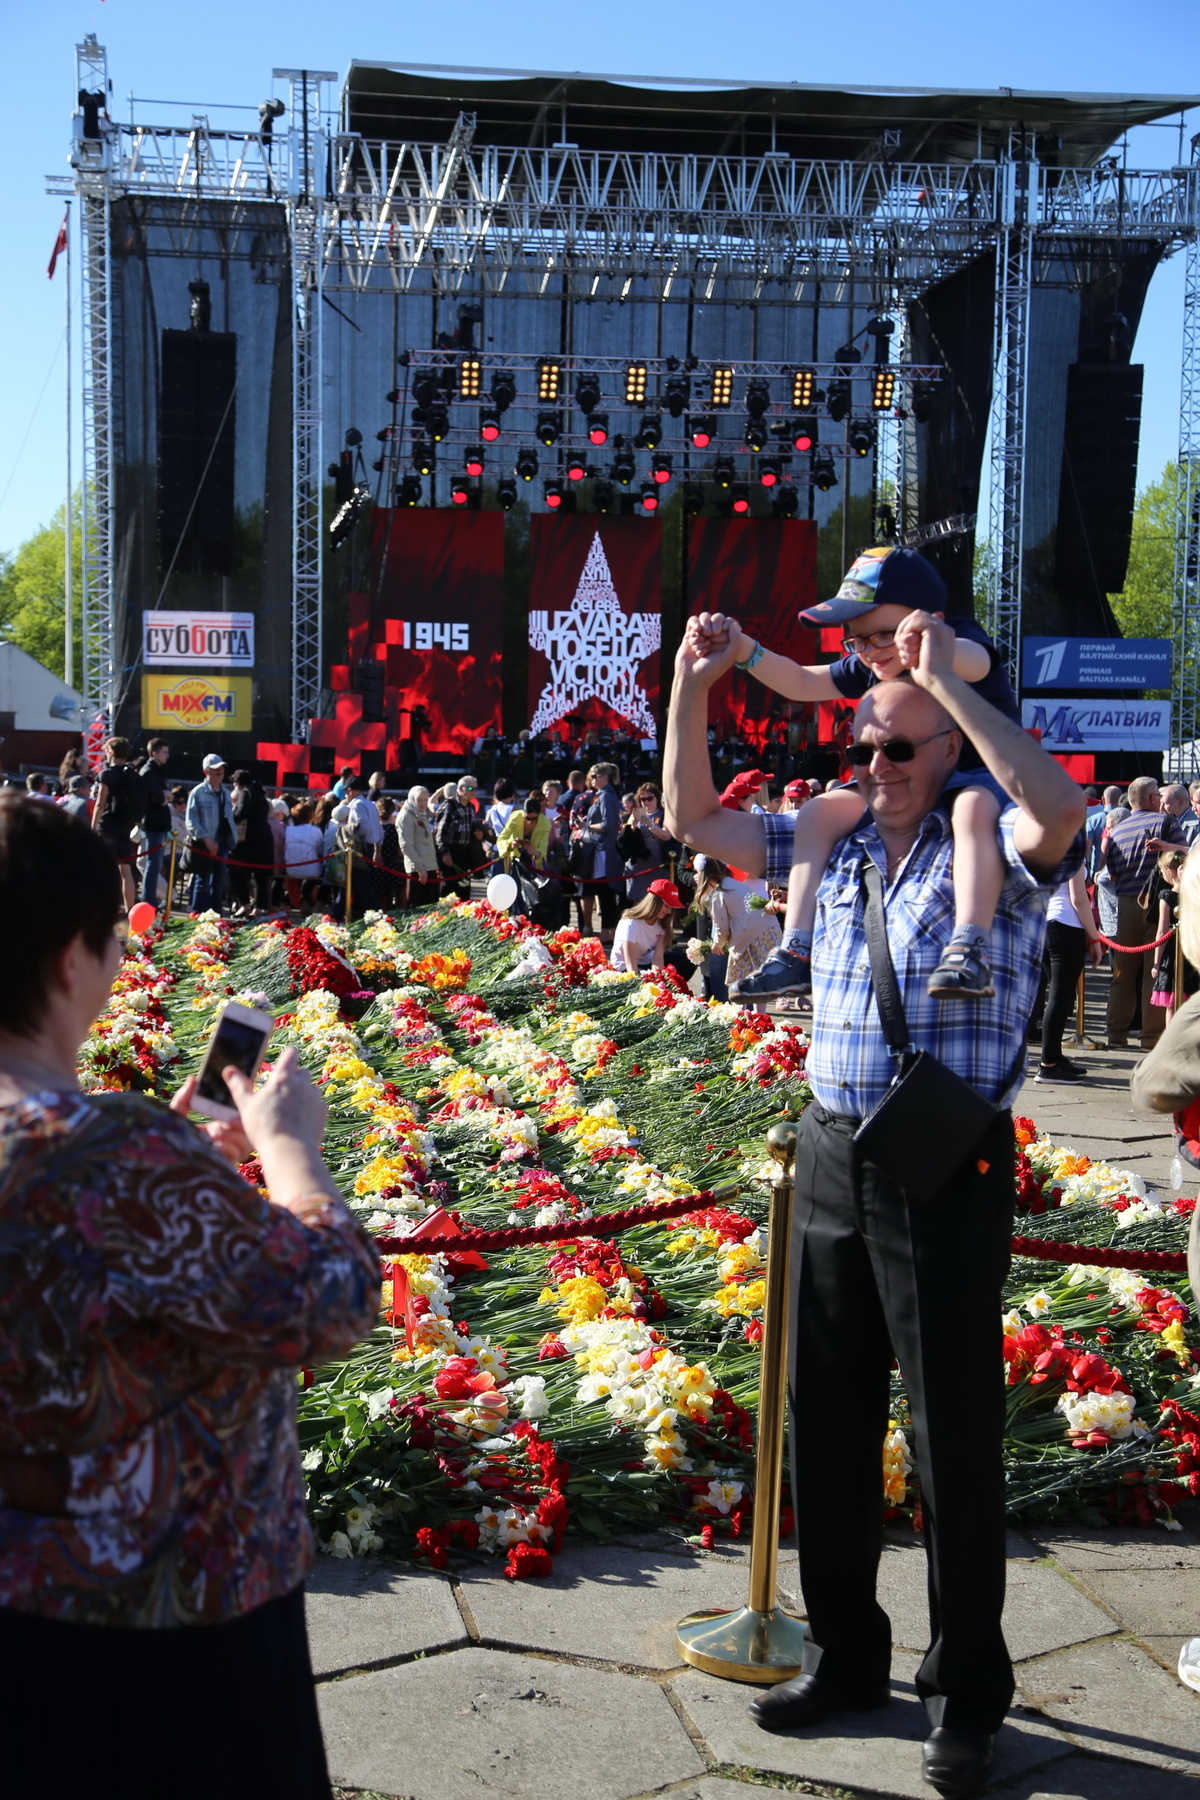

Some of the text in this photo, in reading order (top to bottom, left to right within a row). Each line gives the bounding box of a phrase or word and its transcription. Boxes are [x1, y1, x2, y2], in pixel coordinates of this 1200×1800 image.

[541, 610, 646, 639] UZVARA
[403, 621, 469, 651] 1945
[545, 633, 646, 661] ПОБЕДА
[1080, 643, 1115, 652] ПЕРВЫЙ
[1079, 652, 1167, 661] БАЛТИЙСКИЙ КАНАЛ
[550, 657, 640, 686] VICTORY
[1079, 667, 1112, 675] PIRMAIS
[1079, 675, 1114, 683] BALTIJAS
[1087, 711, 1162, 727] ЛАТВИЯ
